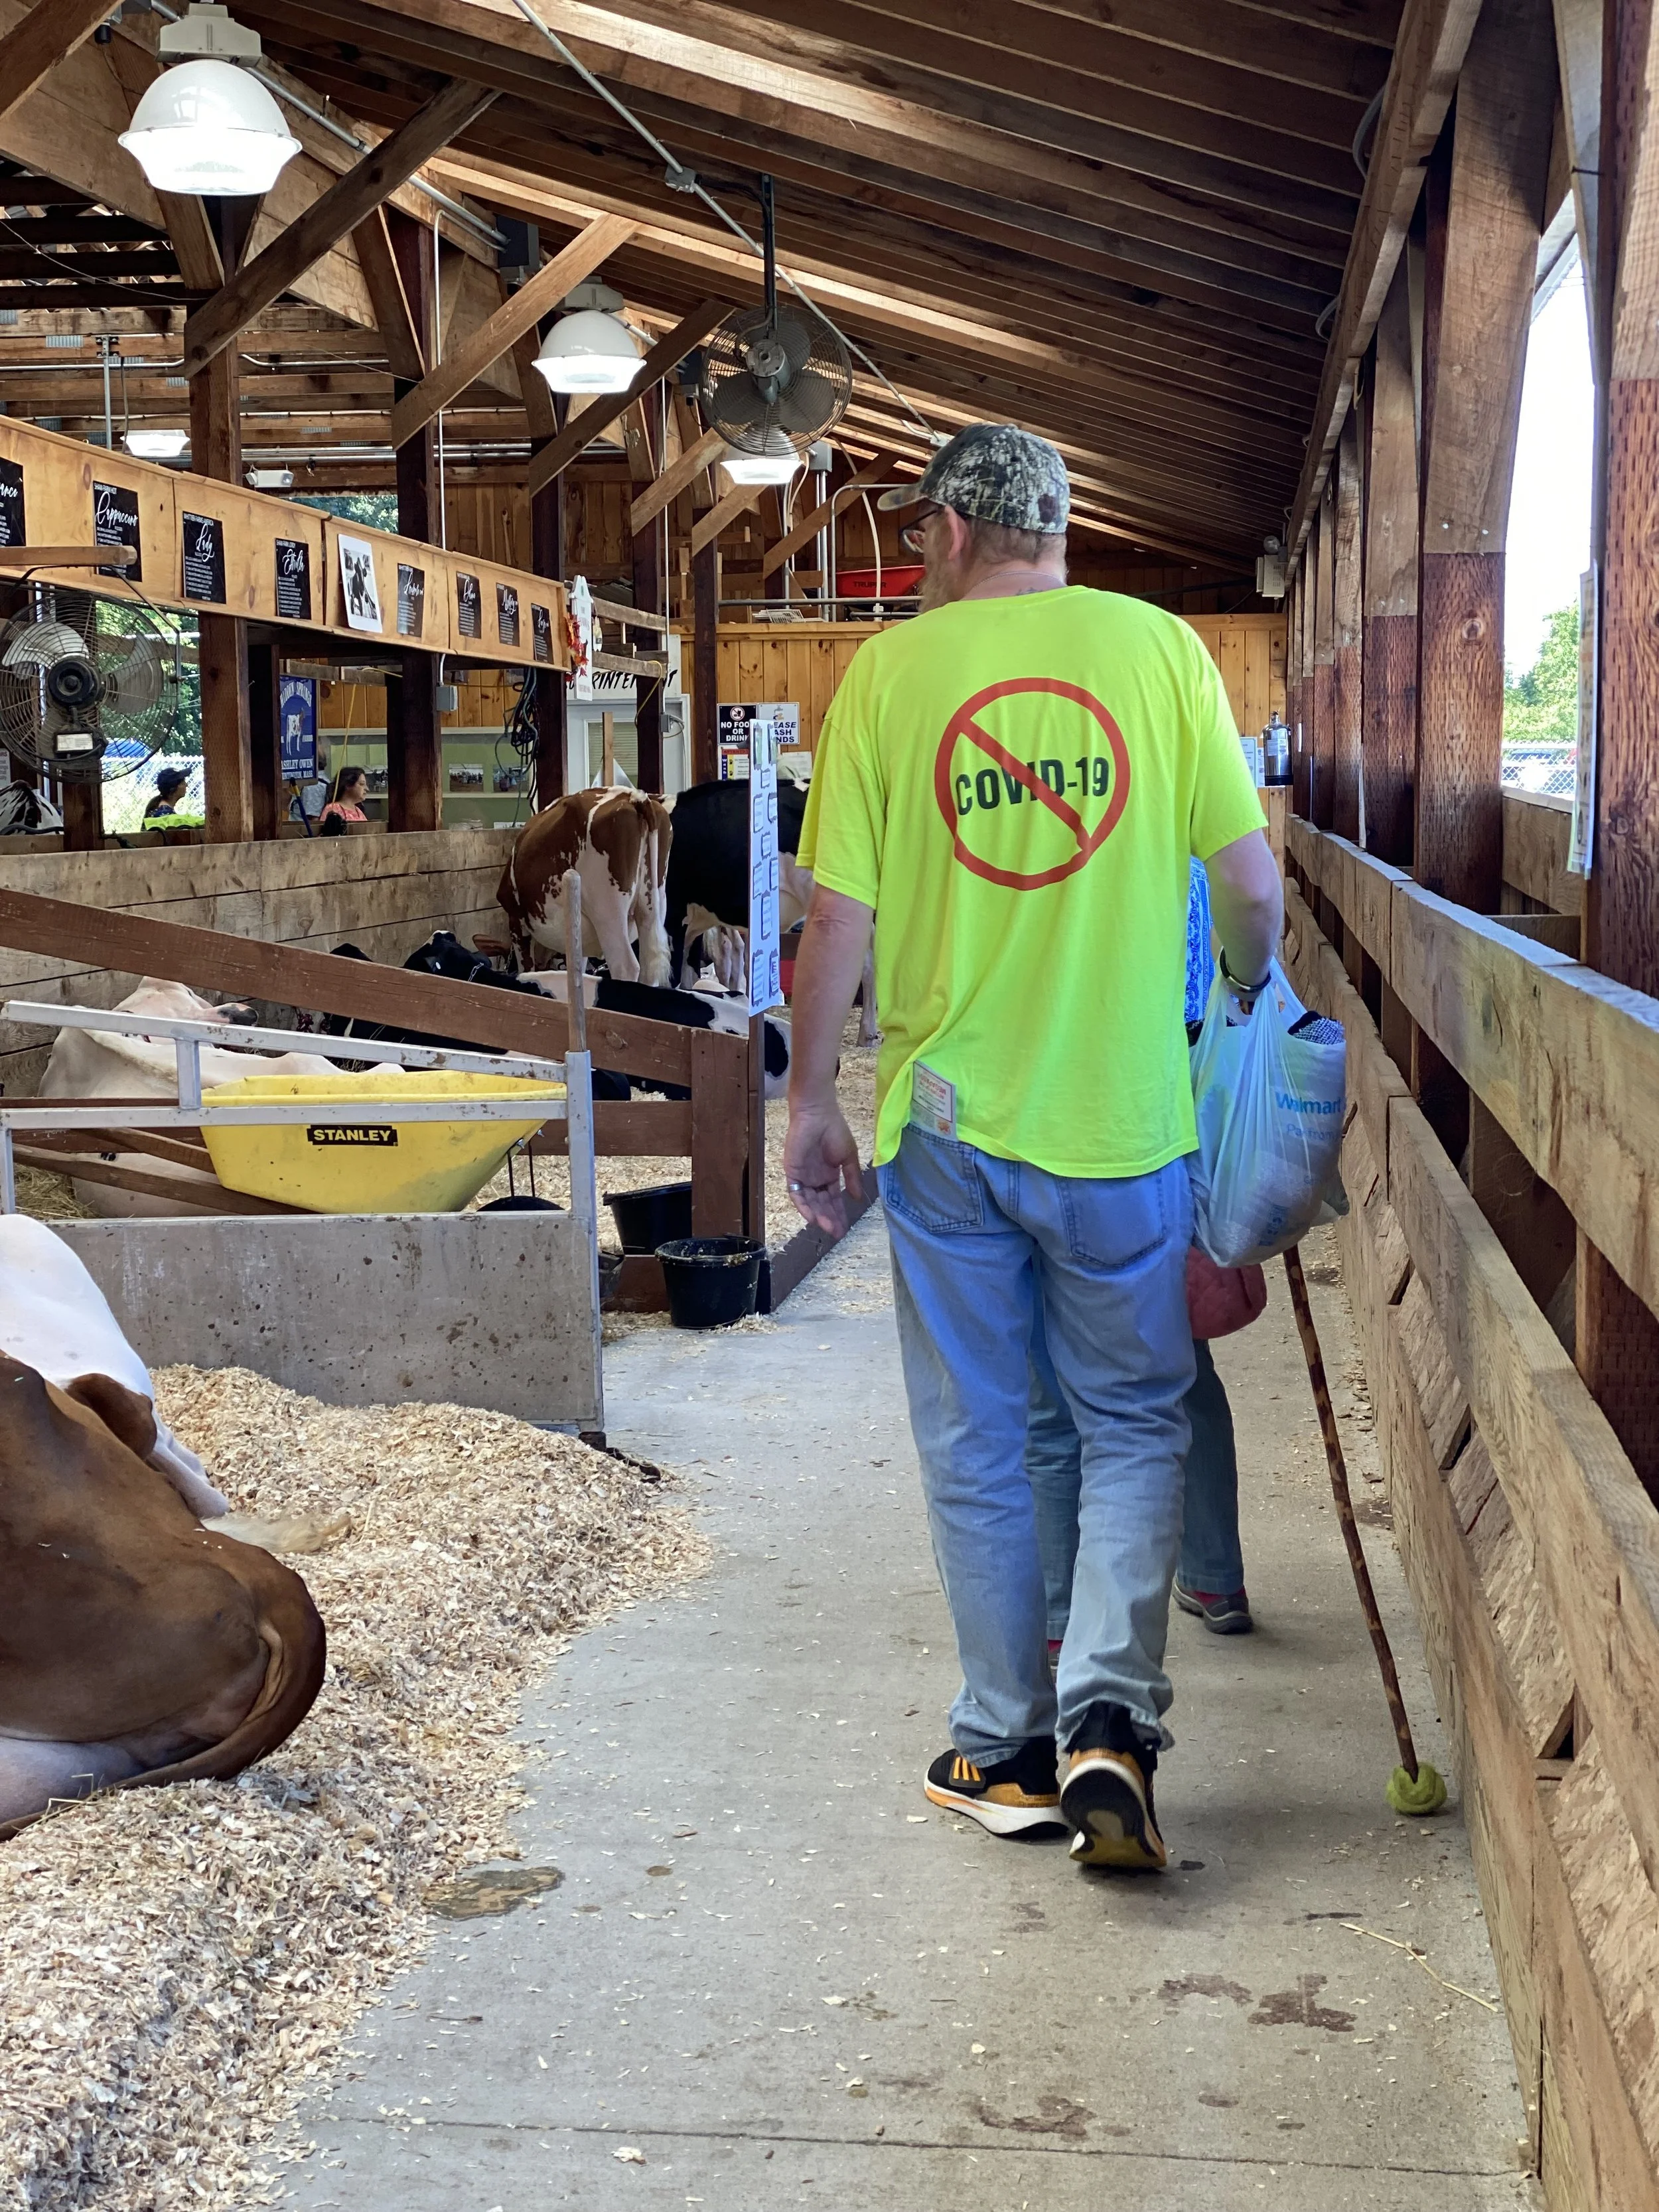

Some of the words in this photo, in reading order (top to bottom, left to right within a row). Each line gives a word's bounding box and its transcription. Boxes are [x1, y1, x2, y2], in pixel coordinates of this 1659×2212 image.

[281, 759, 299, 769] SHLEY
[956, 757, 1109, 816] COVID-19
[313, 1129, 390, 1142] STANLEY
